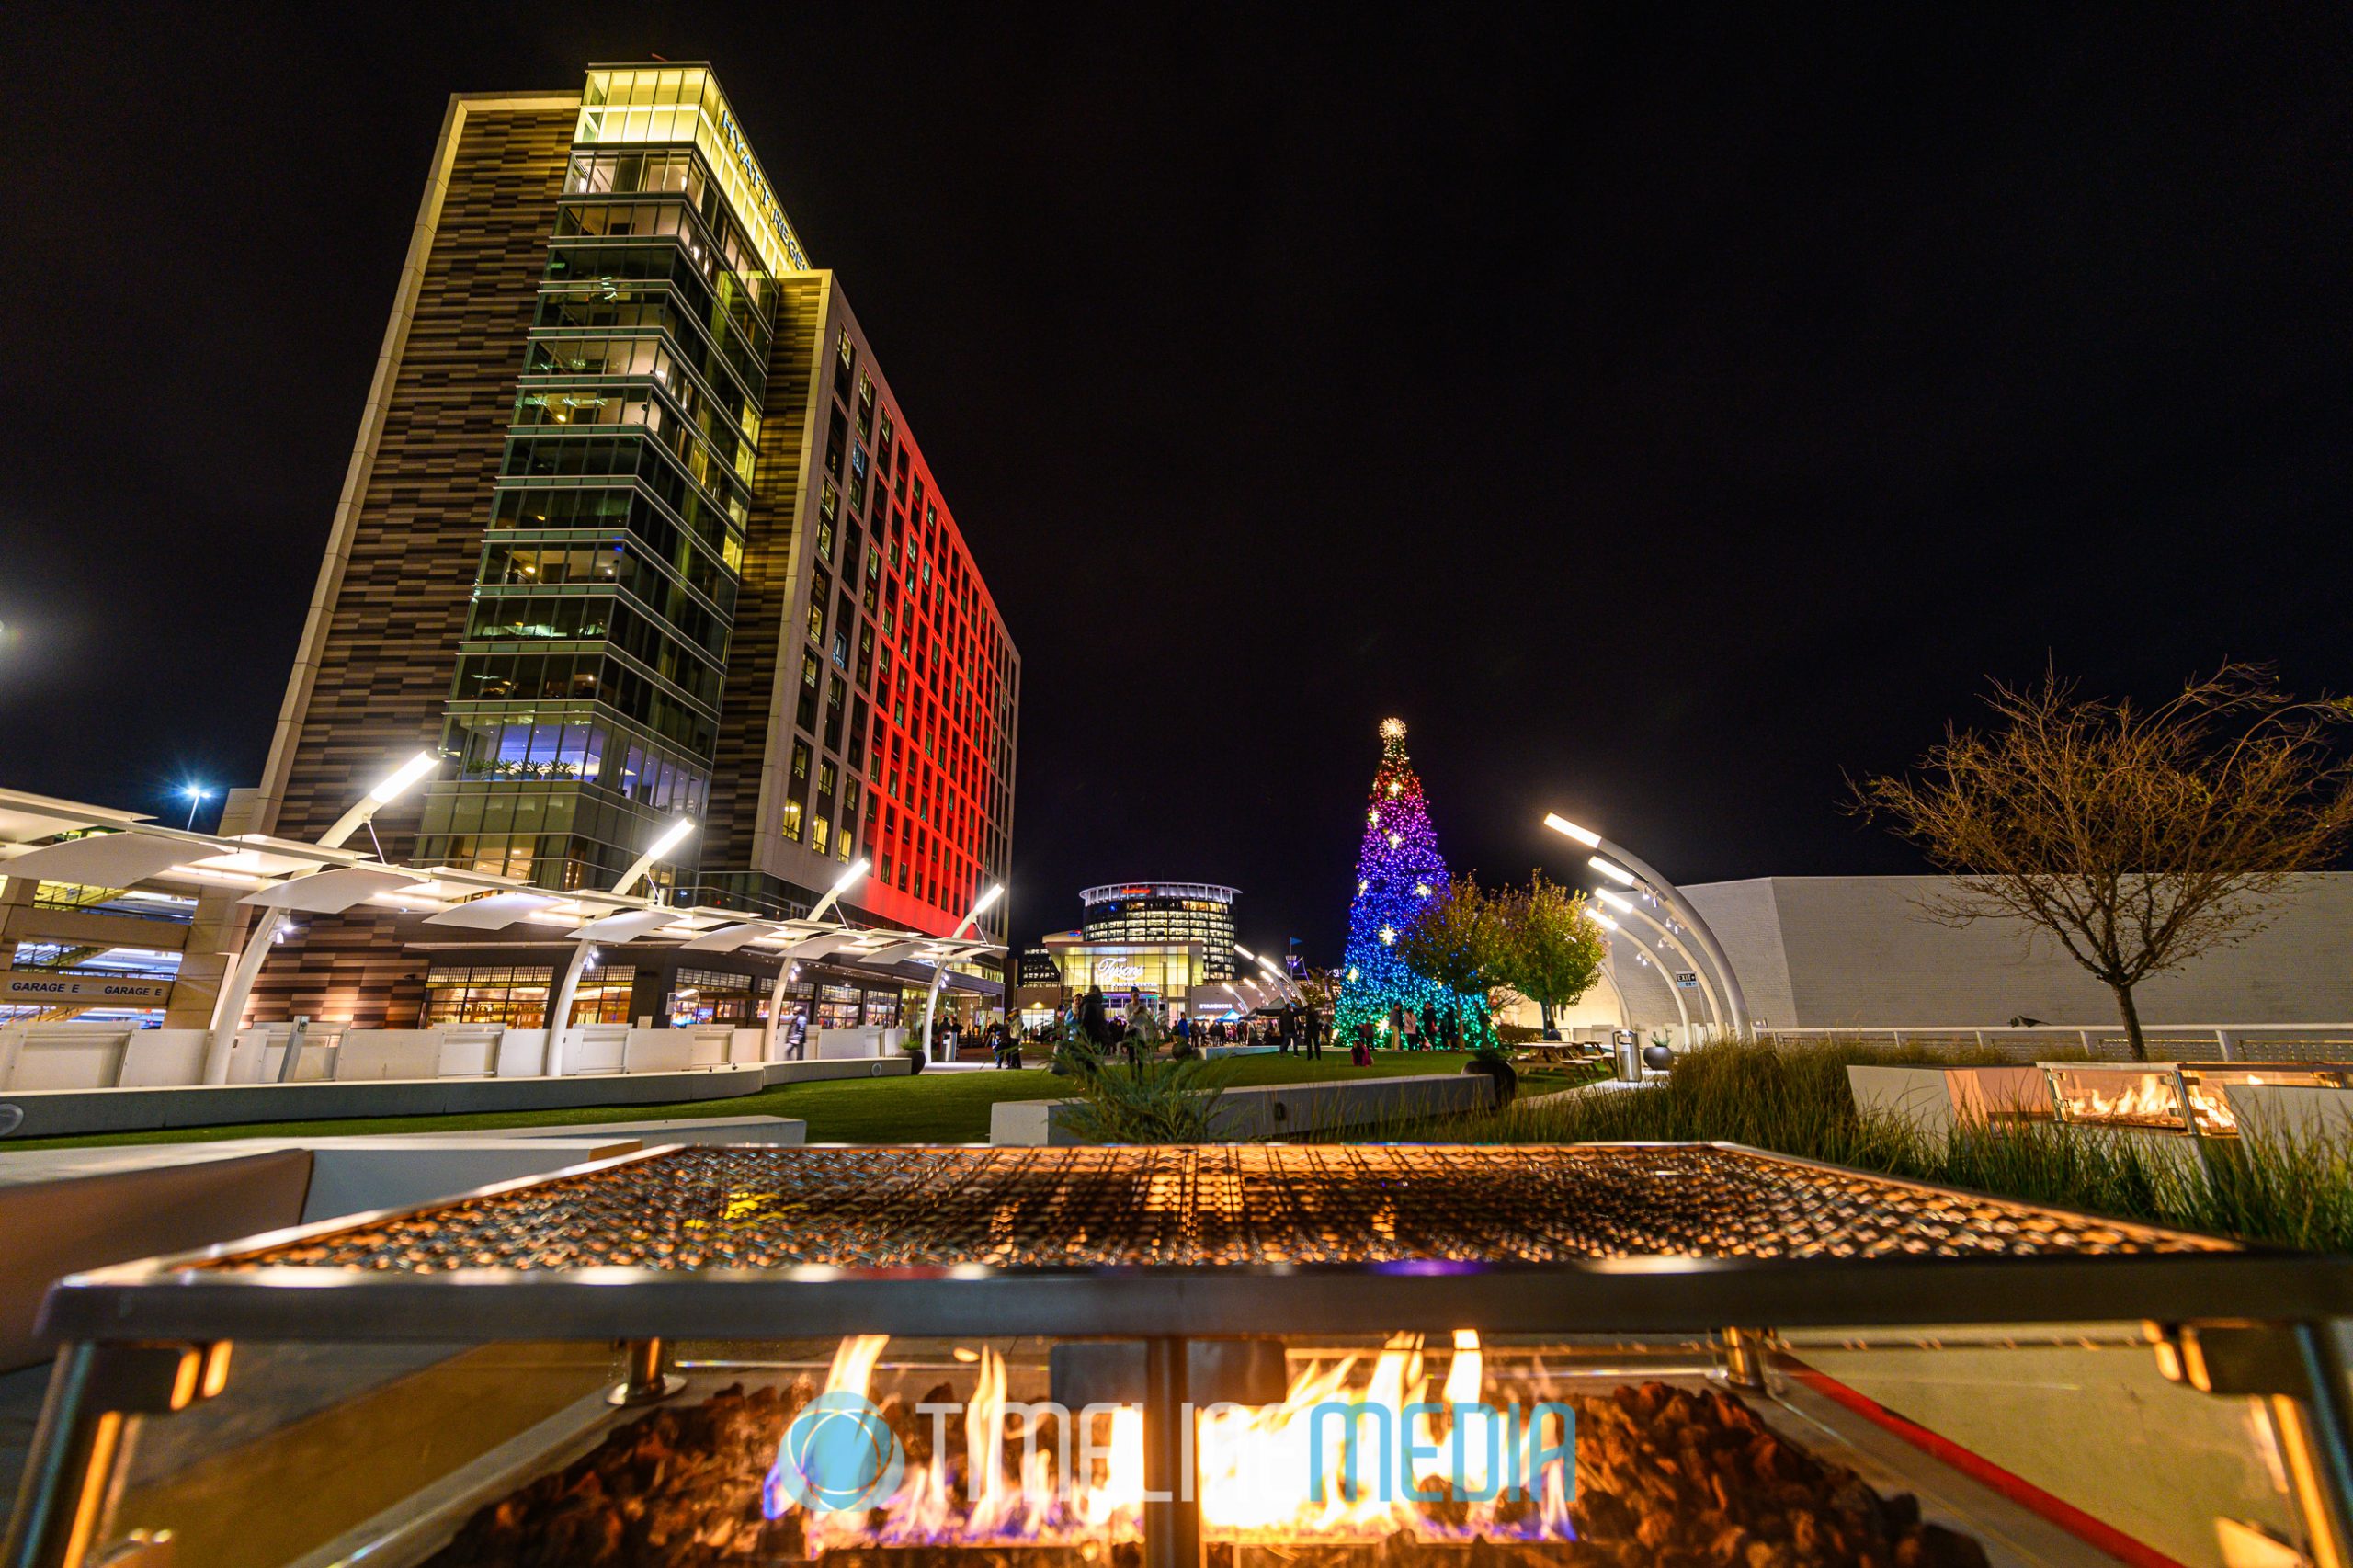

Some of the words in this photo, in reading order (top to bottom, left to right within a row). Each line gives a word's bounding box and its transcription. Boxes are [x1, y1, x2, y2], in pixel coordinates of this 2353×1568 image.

[722, 110, 770, 206] HYATT
[1097, 957, 1144, 982] Tysons
[12, 982, 66, 993] GARAGE
[71, 983, 81, 994] E
[104, 985, 151, 996] GARAGE
[154, 988, 163, 996] E
